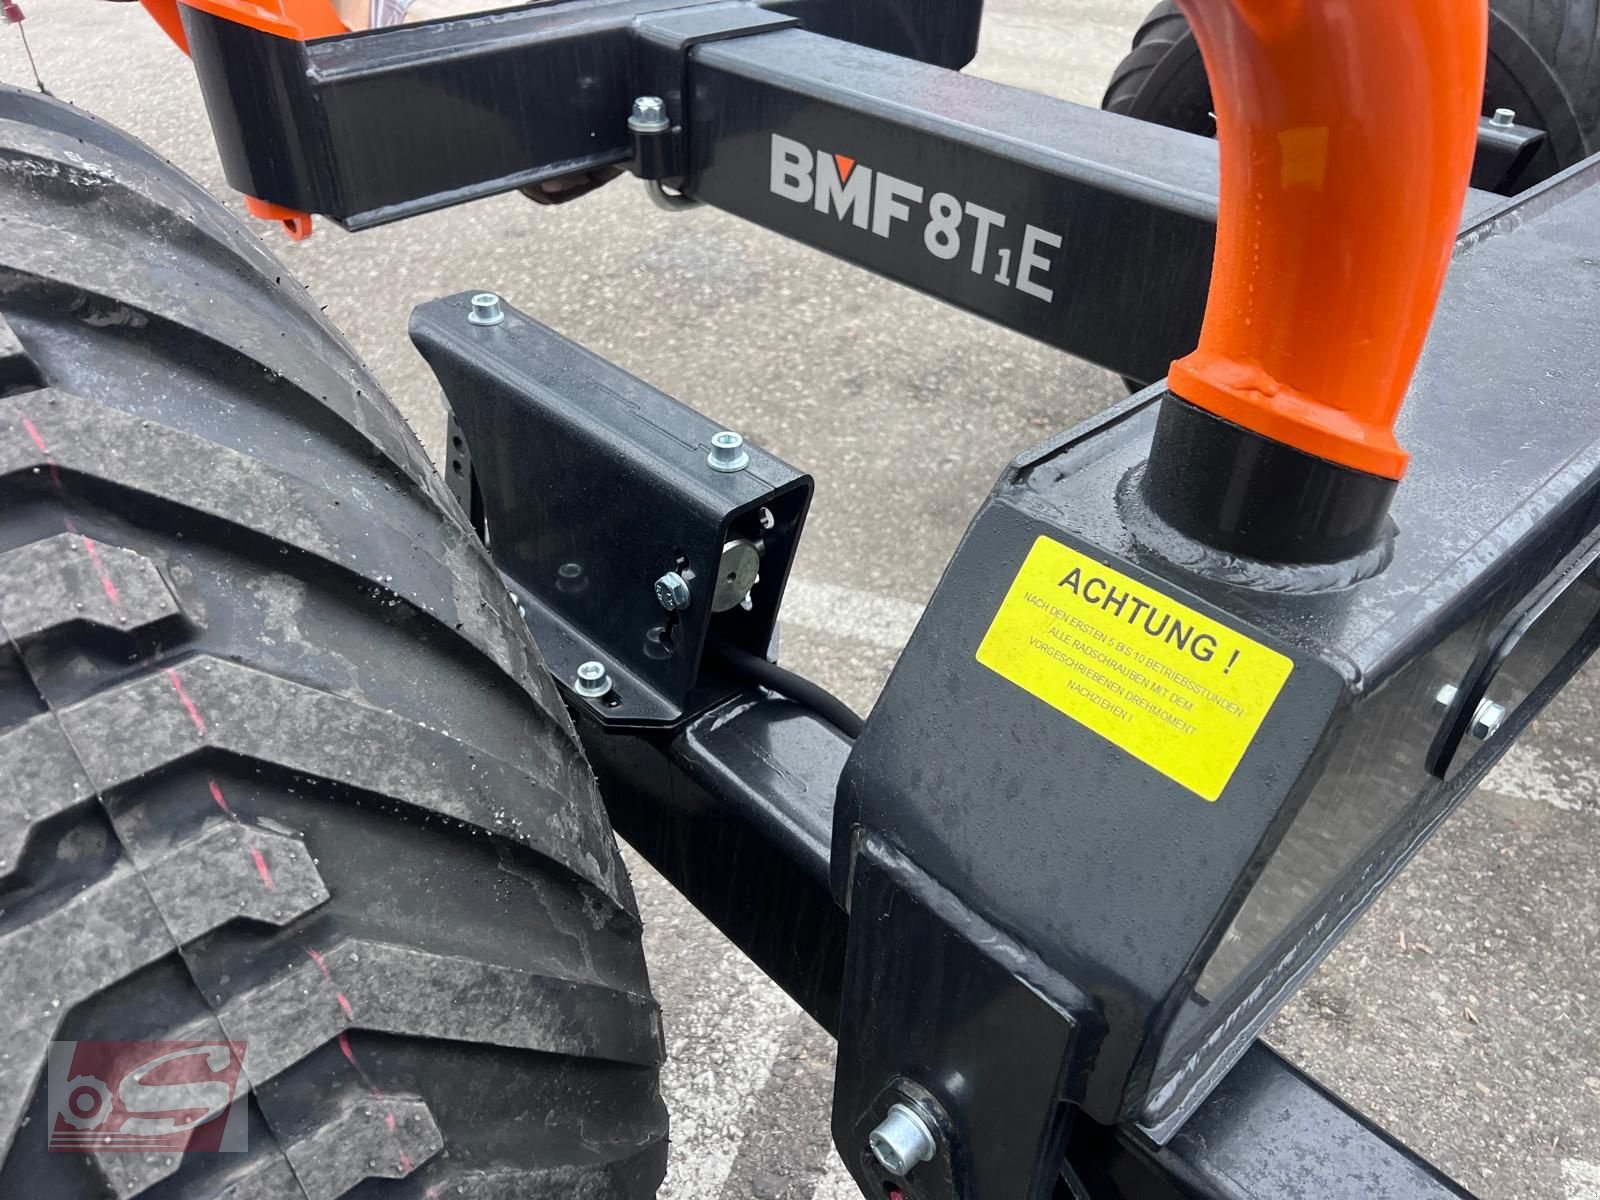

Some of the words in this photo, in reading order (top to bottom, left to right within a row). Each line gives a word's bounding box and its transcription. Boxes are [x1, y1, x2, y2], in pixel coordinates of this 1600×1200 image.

[770, 133, 924, 239] BMF
[1023, 591, 1050, 611] NACH
[1049, 606, 1070, 622] DEN
[1069, 617, 1108, 643] ERSTEN
[1107, 638, 1115, 647] 5
[1115, 642, 1133, 656] BIS
[1134, 652, 1145, 663] 10
[1145, 658, 1245, 717] BETRIEBSSTUNDEN
[1048, 627, 1073, 644] ALLE
[1072, 640, 1150, 688] RADSCHRAUBEN
[1150, 682, 1170, 697] MIT
[1169, 693, 1194, 712] DEM
[1057, 567, 1218, 662] ACHTUNG
[1223, 649, 1241, 674] !
[1029, 636, 1125, 695] VORGESCHRIEBENEN
[1124, 690, 1198, 735] DREHMOMENT
[1067, 680, 1128, 720] NACHZIEHEN
